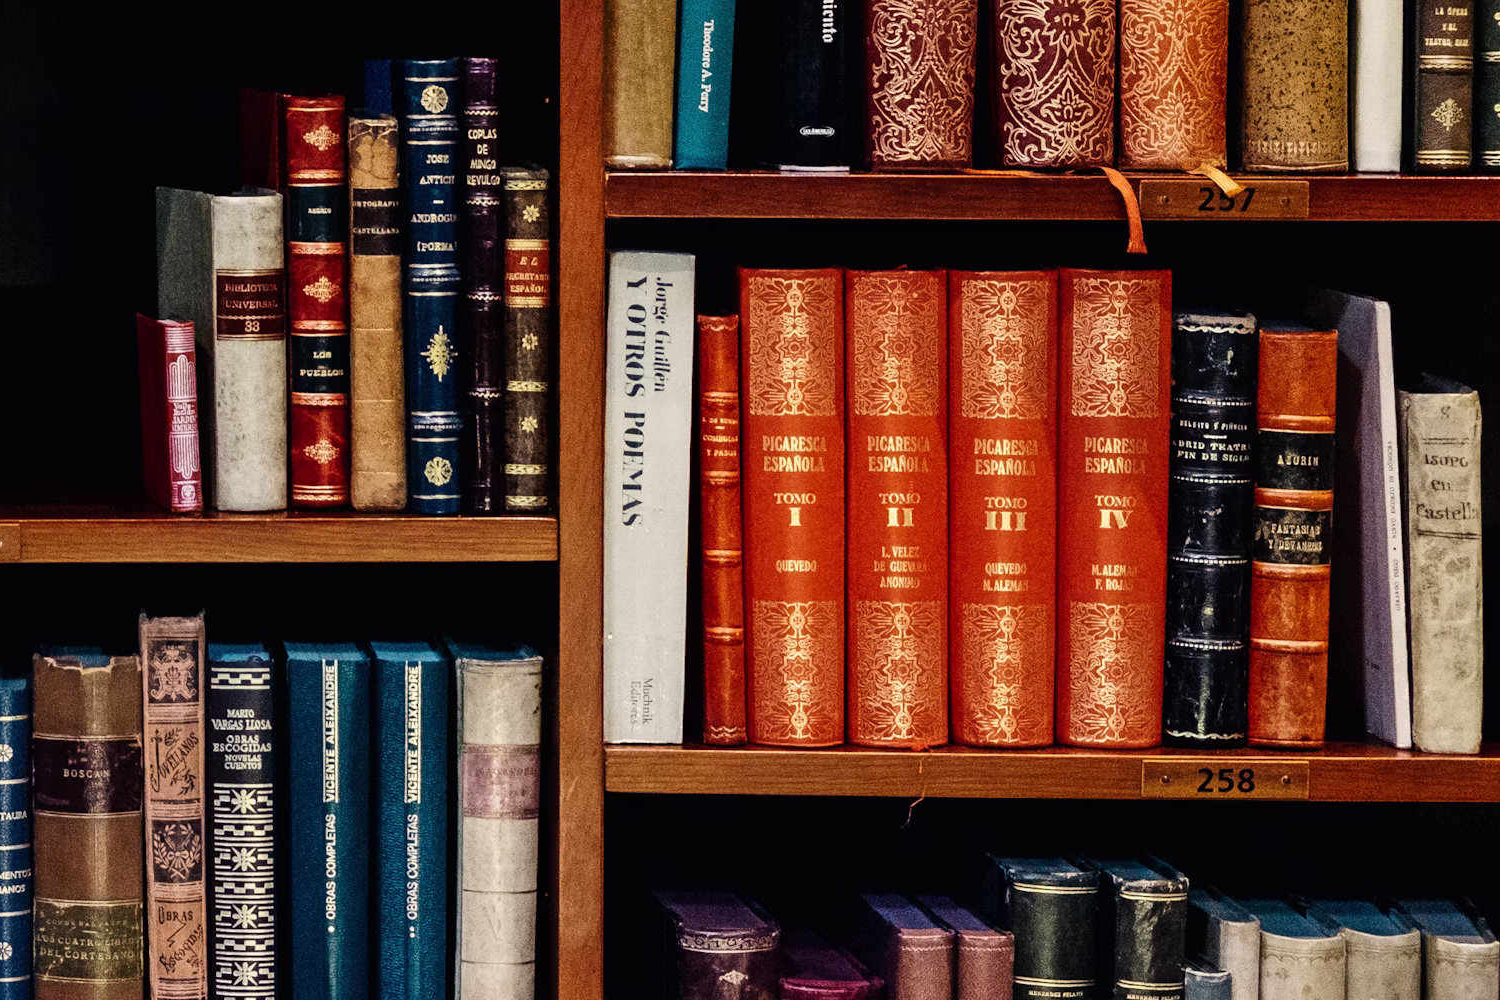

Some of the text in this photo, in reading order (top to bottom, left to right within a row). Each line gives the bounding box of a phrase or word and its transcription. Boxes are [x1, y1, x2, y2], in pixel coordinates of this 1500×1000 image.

[698, 19, 715, 113] Theodore A. Perry
[468, 129, 497, 139] COPLAS
[477, 144, 488, 154] DE
[426, 154, 449, 164] JOSE
[470, 159, 496, 170] MINGO
[225, 283, 277, 292] BIBLIOTECA
[225, 300, 277, 308] UNIVERSAL
[651, 277, 673, 392] Jorge Guillén
[622, 276, 647, 526] Y OTROS POEMAS
[762, 435, 826, 452] PICARESCA
[867, 435, 930, 452] PICARESCA
[974, 438, 1038, 456] PICARESCA
[1084, 436, 1148, 454] PICARESCA
[763, 454, 824, 472] ESPAÑOLA
[869, 455, 928, 472] ESPAÑOLA
[975, 457, 1035, 475] ESPAÑOLA
[1085, 456, 1146, 474] ESPAÑOLA
[774, 492, 815, 504] TOMO
[879, 492, 920, 504] TOMO
[984, 497, 1027, 508] TOMO
[1094, 495, 1136, 507] TOMO
[985, 511, 1027, 531] III
[776, 560, 817, 572] QUEVEDO
[985, 562, 1026, 575] QUEVEDO
[227, 709, 254, 718] MARIO
[212, 719, 272, 730] VARGAS LLOSA
[227, 735, 259, 743] OBRAS
[326, 666, 335, 802] VICENTE ALEIXANDRE
[408, 666, 418, 802] VICENTE ALEIXANDRE
[213, 743, 271, 752] ESCOGIDAS
[63, 769, 110, 778] BOSCAN
[1197, 769, 1255, 792] 258
[326, 814, 335, 920] OBRAS COMPLETAS
[407, 814, 418, 920] OBRAS COMPLETAS
